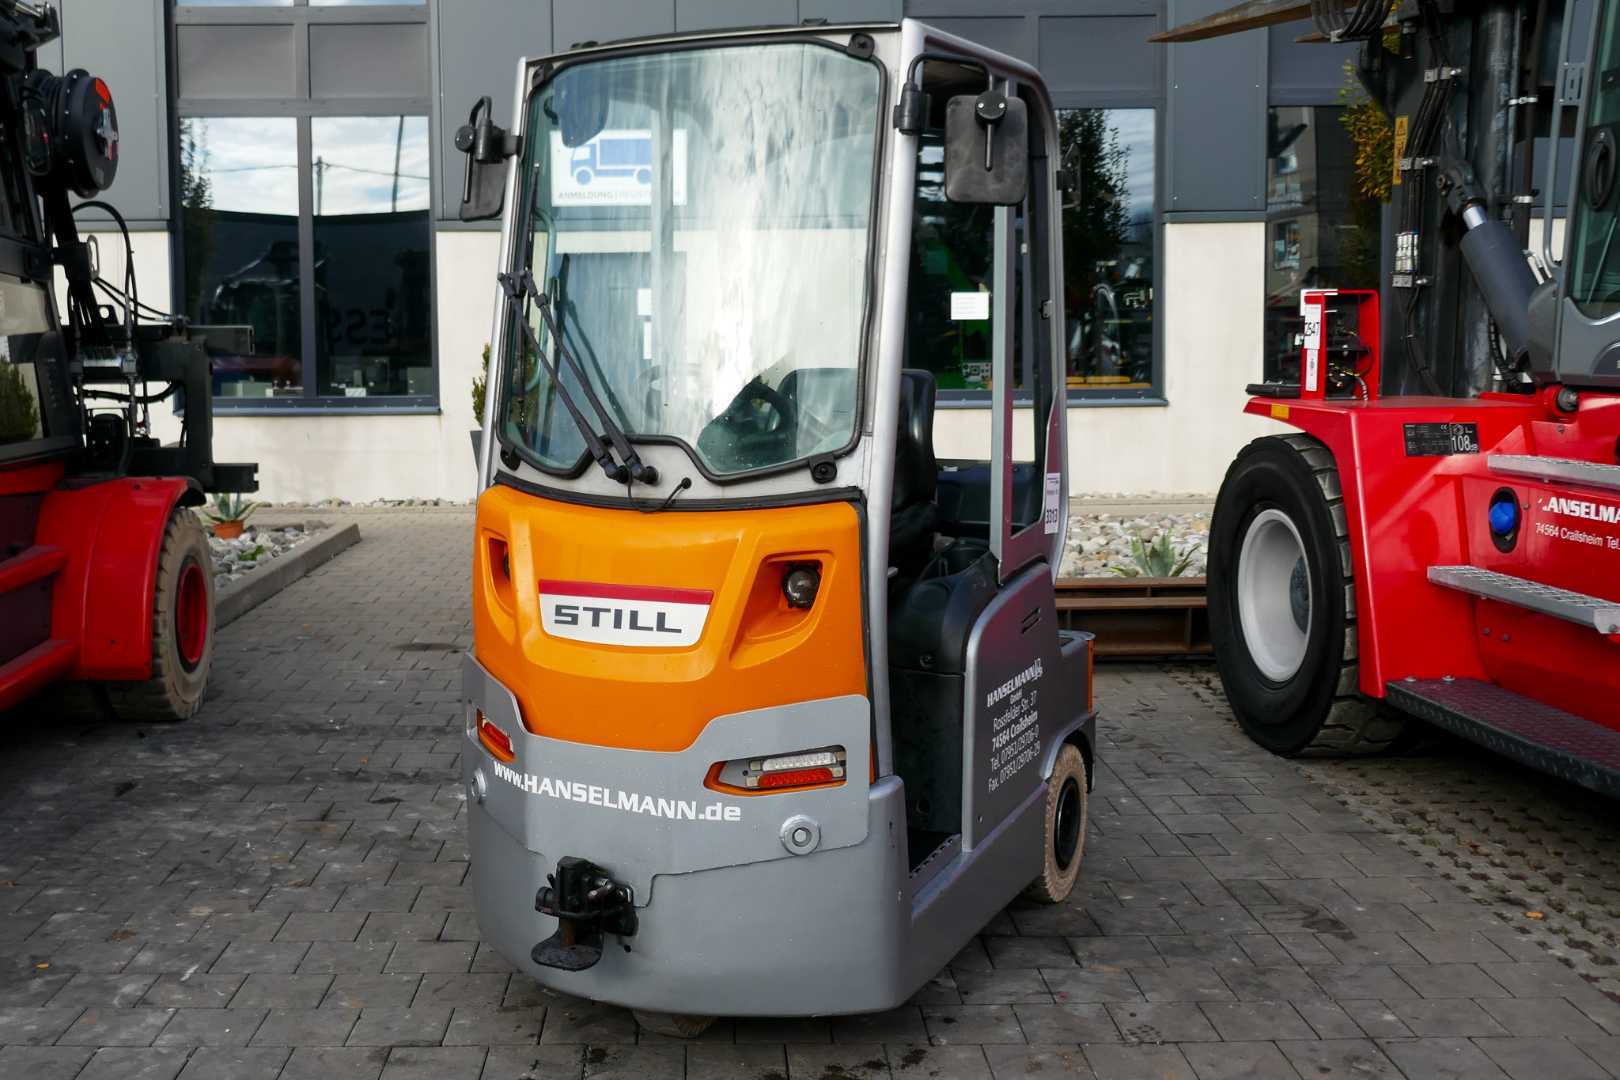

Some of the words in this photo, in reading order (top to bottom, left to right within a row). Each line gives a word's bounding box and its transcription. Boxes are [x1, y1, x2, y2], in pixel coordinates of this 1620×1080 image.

[1451, 434, 1470, 452] 108
[1560, 527, 1603, 547] Crailsheim
[553, 604, 682, 634] STILL
[987, 663, 1037, 707] HANSELMANN
[992, 728, 1010, 751] 74564
[1010, 711, 1038, 738] Crailsheim
[990, 754, 1001, 772] Tel.
[493, 761, 742, 822] www.HANSELMANN.de
